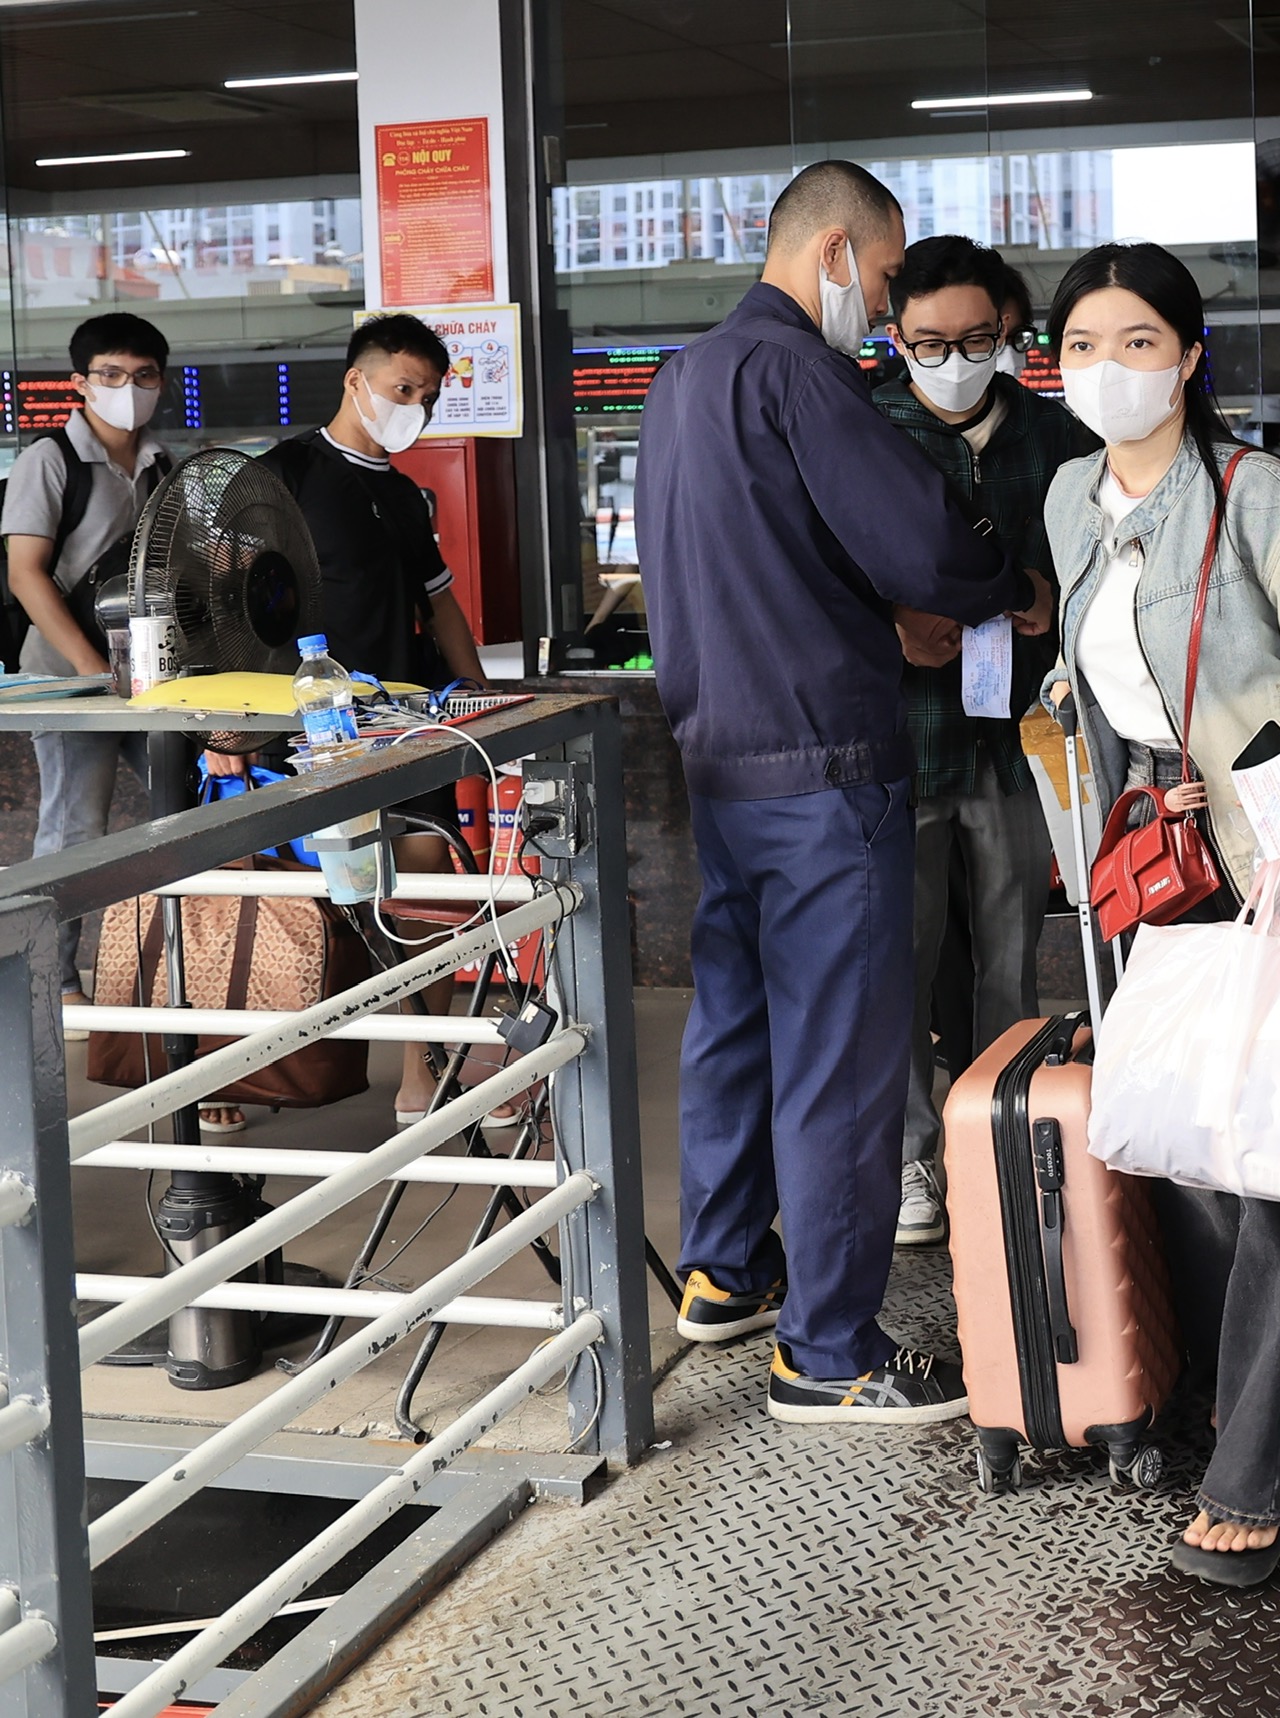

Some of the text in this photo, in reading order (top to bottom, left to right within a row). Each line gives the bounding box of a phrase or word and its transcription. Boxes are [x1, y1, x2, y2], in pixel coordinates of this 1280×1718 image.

[412, 149, 452, 165] NỘI QUY
[468, 319, 497, 334] CHÁY
[451, 344, 459, 354] 3
[486, 342, 494, 351] 4
[1045, 1148, 1054, 1178] TOCOSTO
